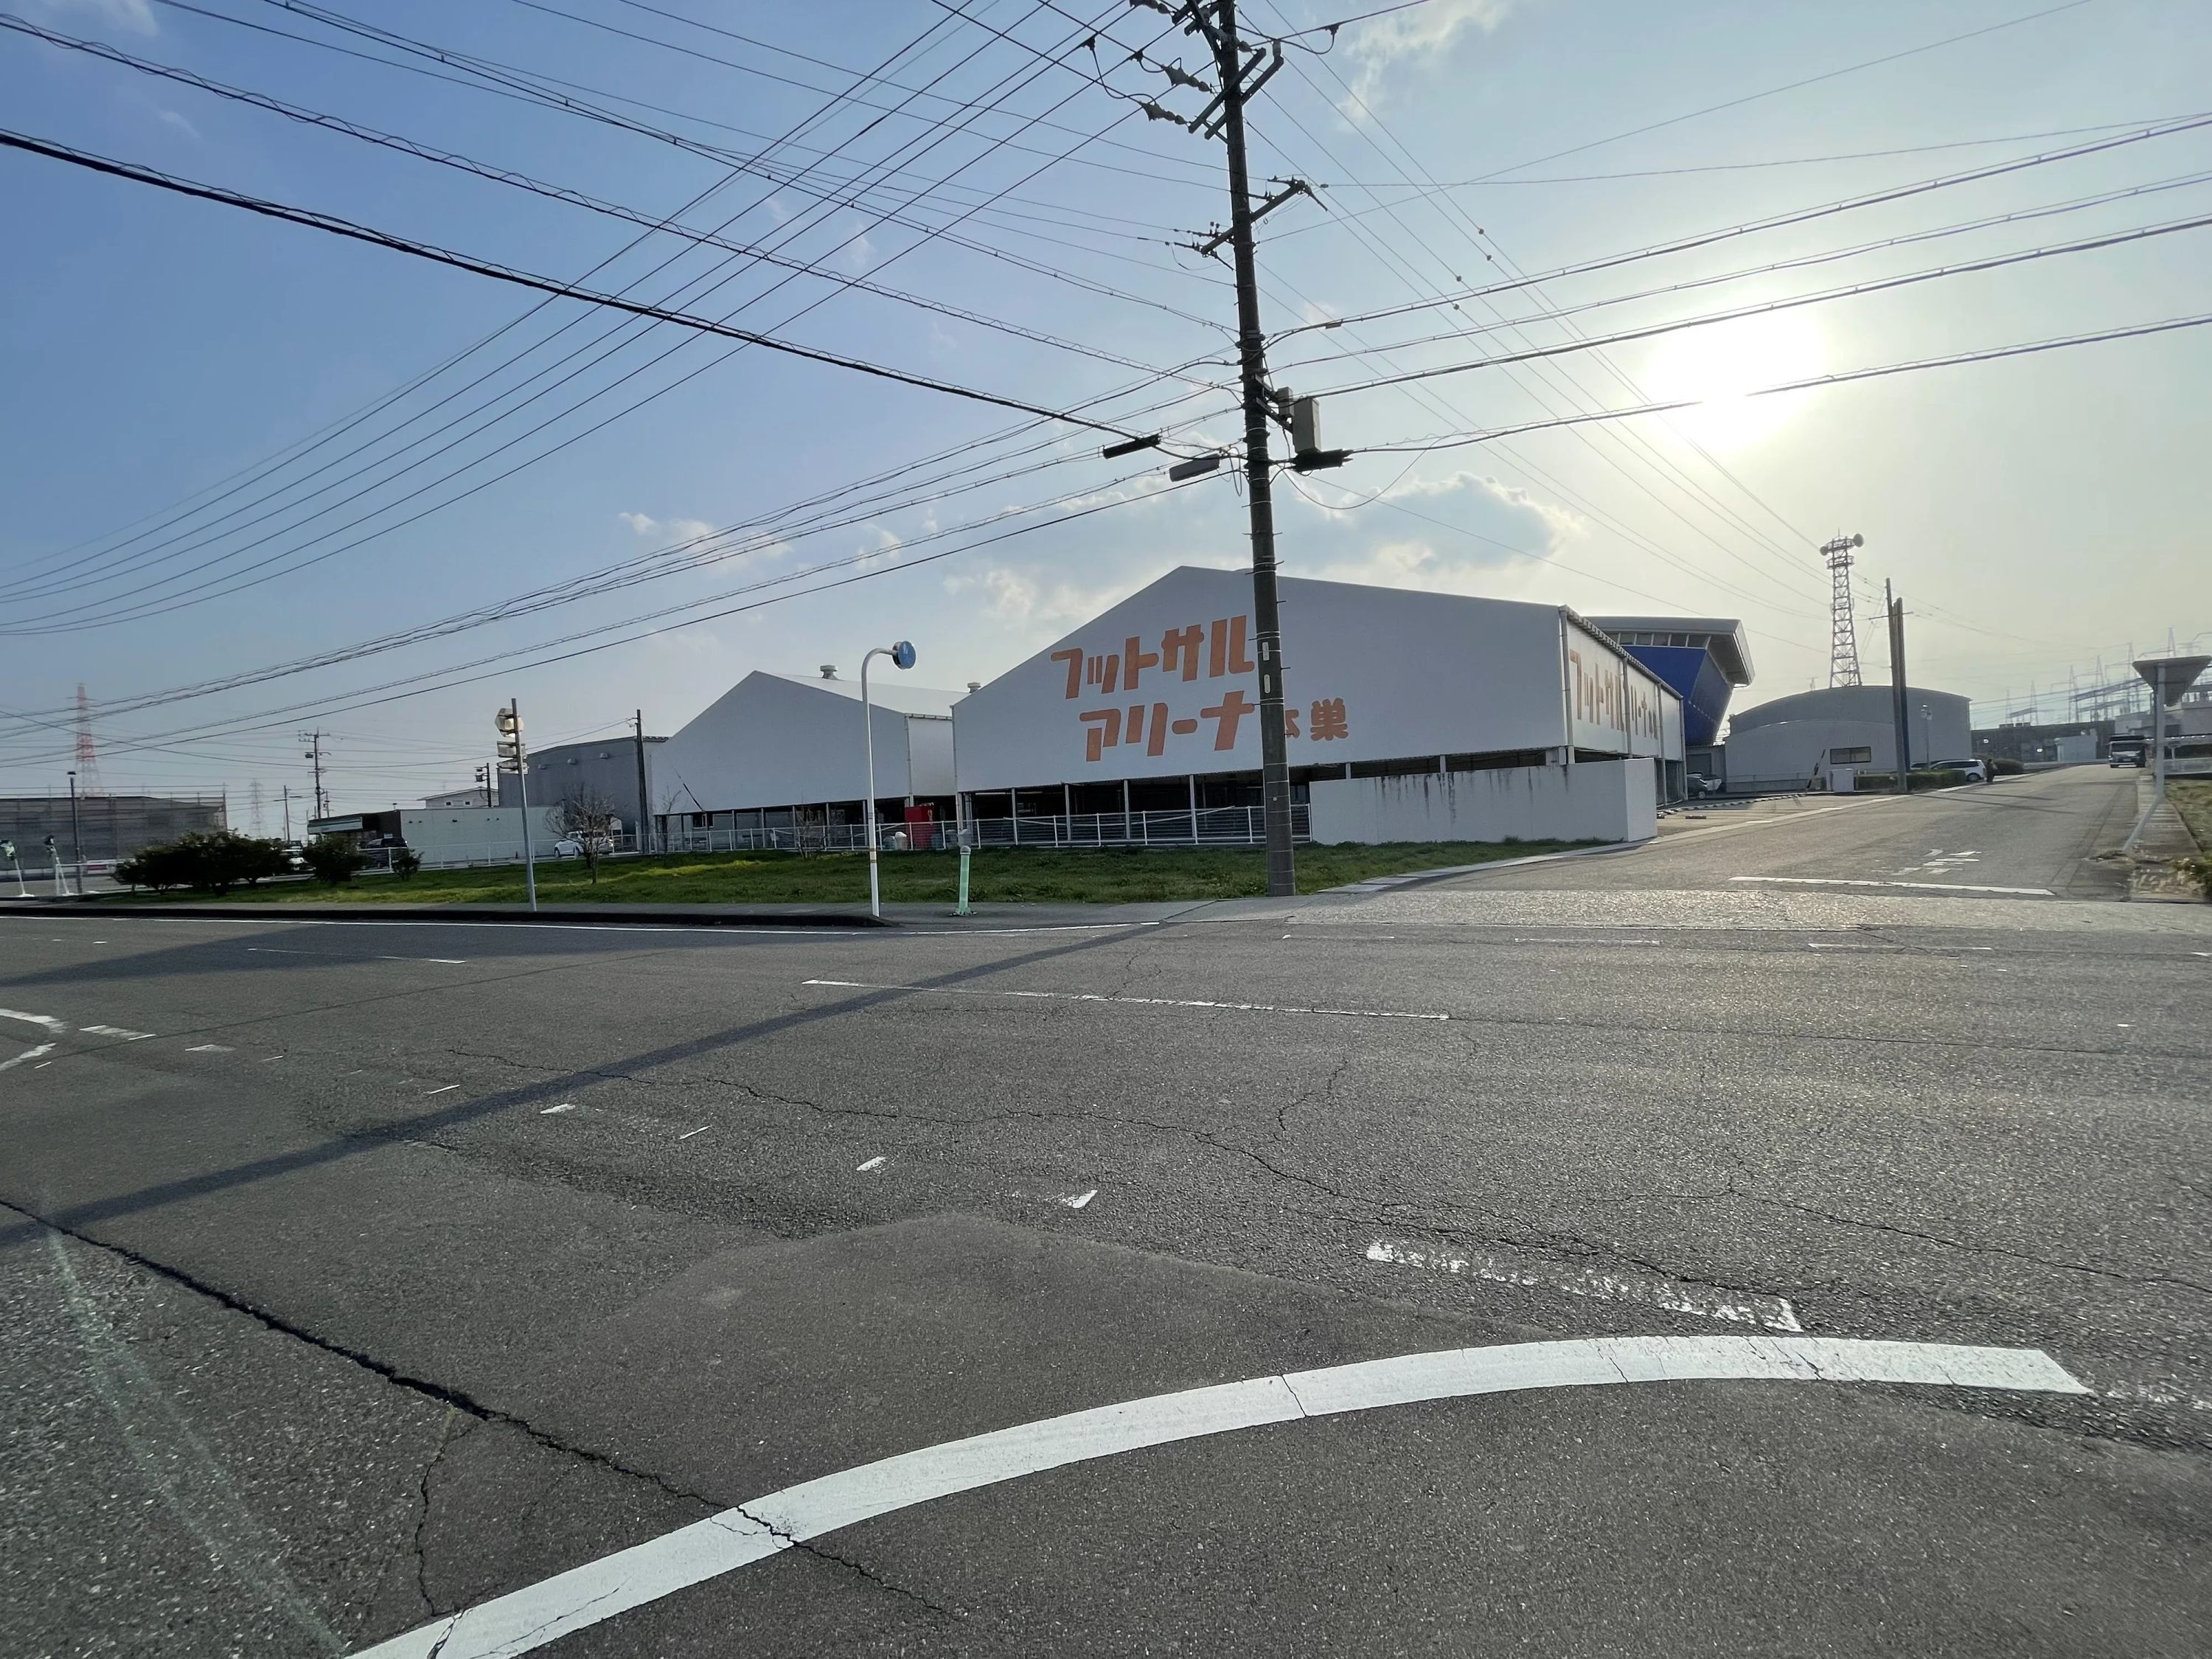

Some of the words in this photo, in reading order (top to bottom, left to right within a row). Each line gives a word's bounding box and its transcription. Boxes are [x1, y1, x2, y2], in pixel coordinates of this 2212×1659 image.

[1051, 615, 1255, 699] フットサル
